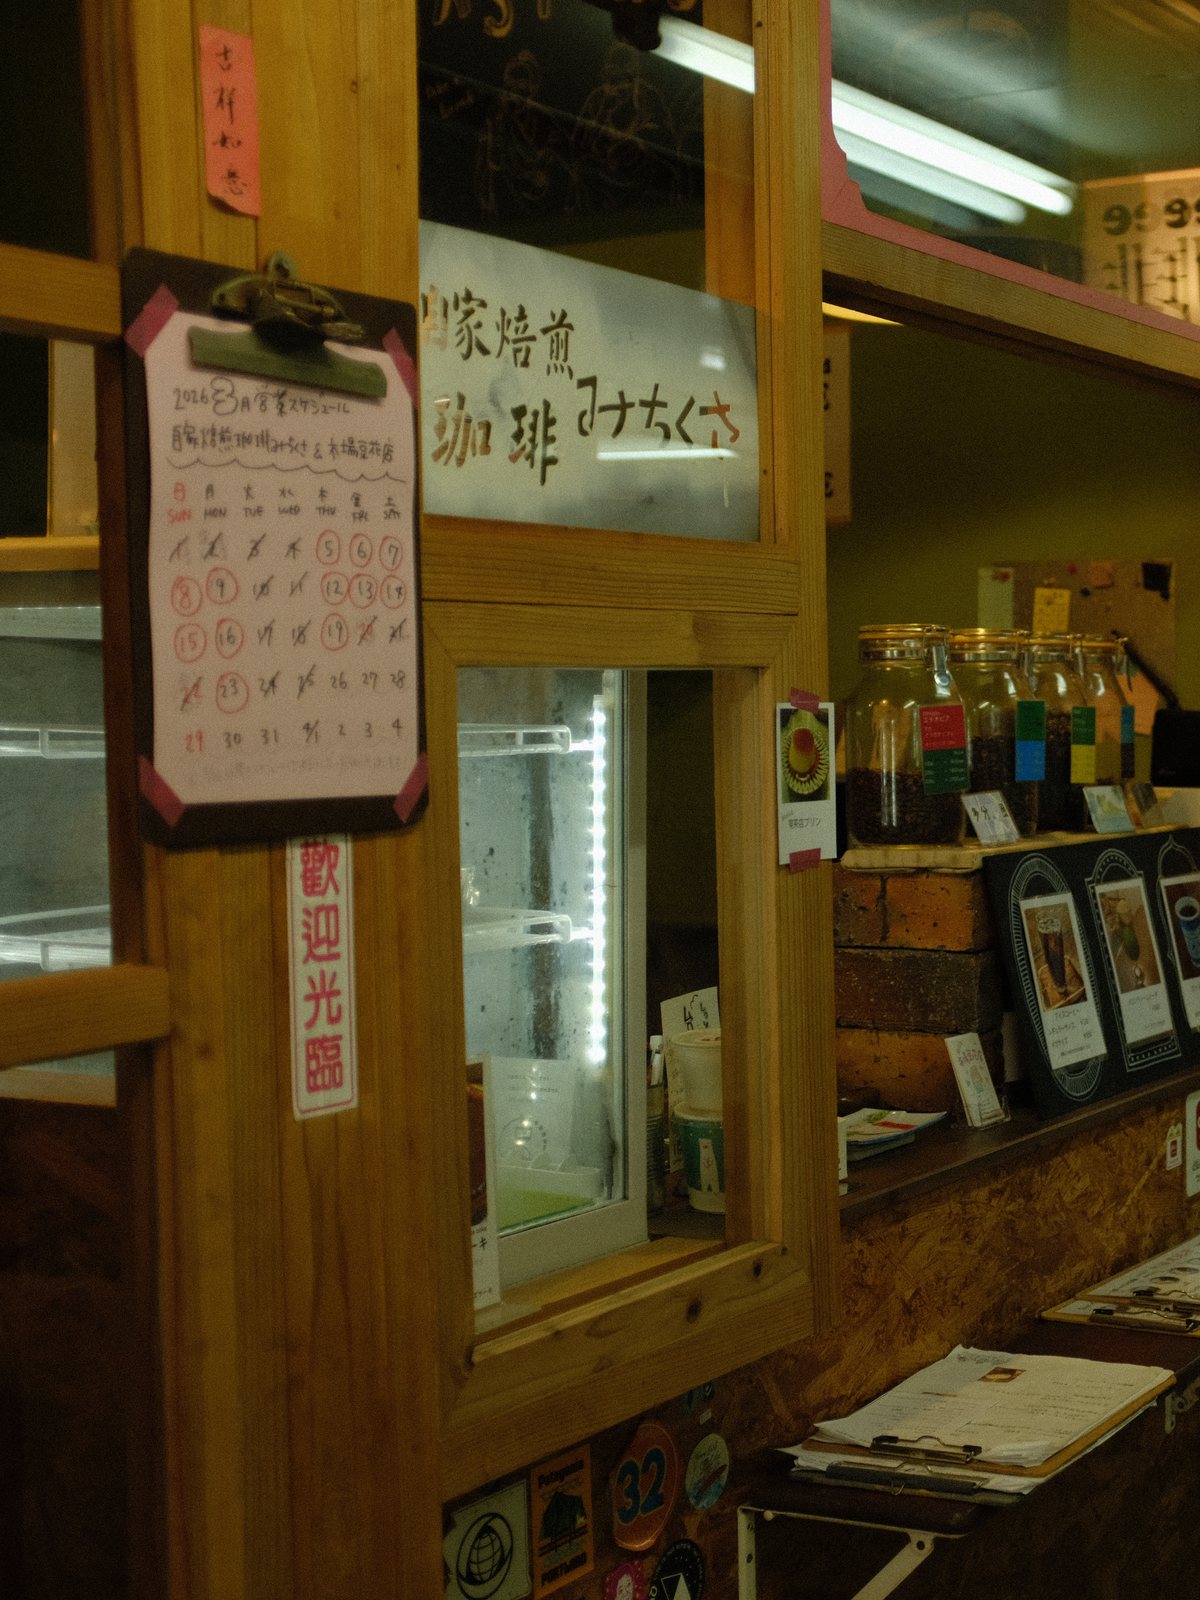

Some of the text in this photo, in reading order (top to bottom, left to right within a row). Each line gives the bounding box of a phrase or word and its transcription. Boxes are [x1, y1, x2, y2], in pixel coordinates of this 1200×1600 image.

[173, 388, 208, 410] 2026
[174, 482, 186, 501] 日
[205, 484, 214, 500] 月
[243, 484, 255, 501] 火
[279, 488, 294, 498] 水
[204, 507, 227, 519] MON
[243, 506, 263, 518] TUE
[316, 507, 336, 516] THU
[388, 544, 399, 566] 7
[326, 579, 343, 597] 12
[358, 579, 373, 599] 13
[386, 579, 403, 599] 14
[180, 631, 197, 651] 15
[219, 624, 236, 645] 16
[327, 621, 344, 642] 19
[220, 679, 239, 699] 23
[330, 673, 348, 690] 26
[362, 672, 378, 688] 27
[390, 671, 406, 689] 28
[185, 717, 403, 752] 29 30 31 4/1 2 3 4
[301, 841, 344, 1094] 歡迎光臨
[615, 1447, 667, 1524] 32
